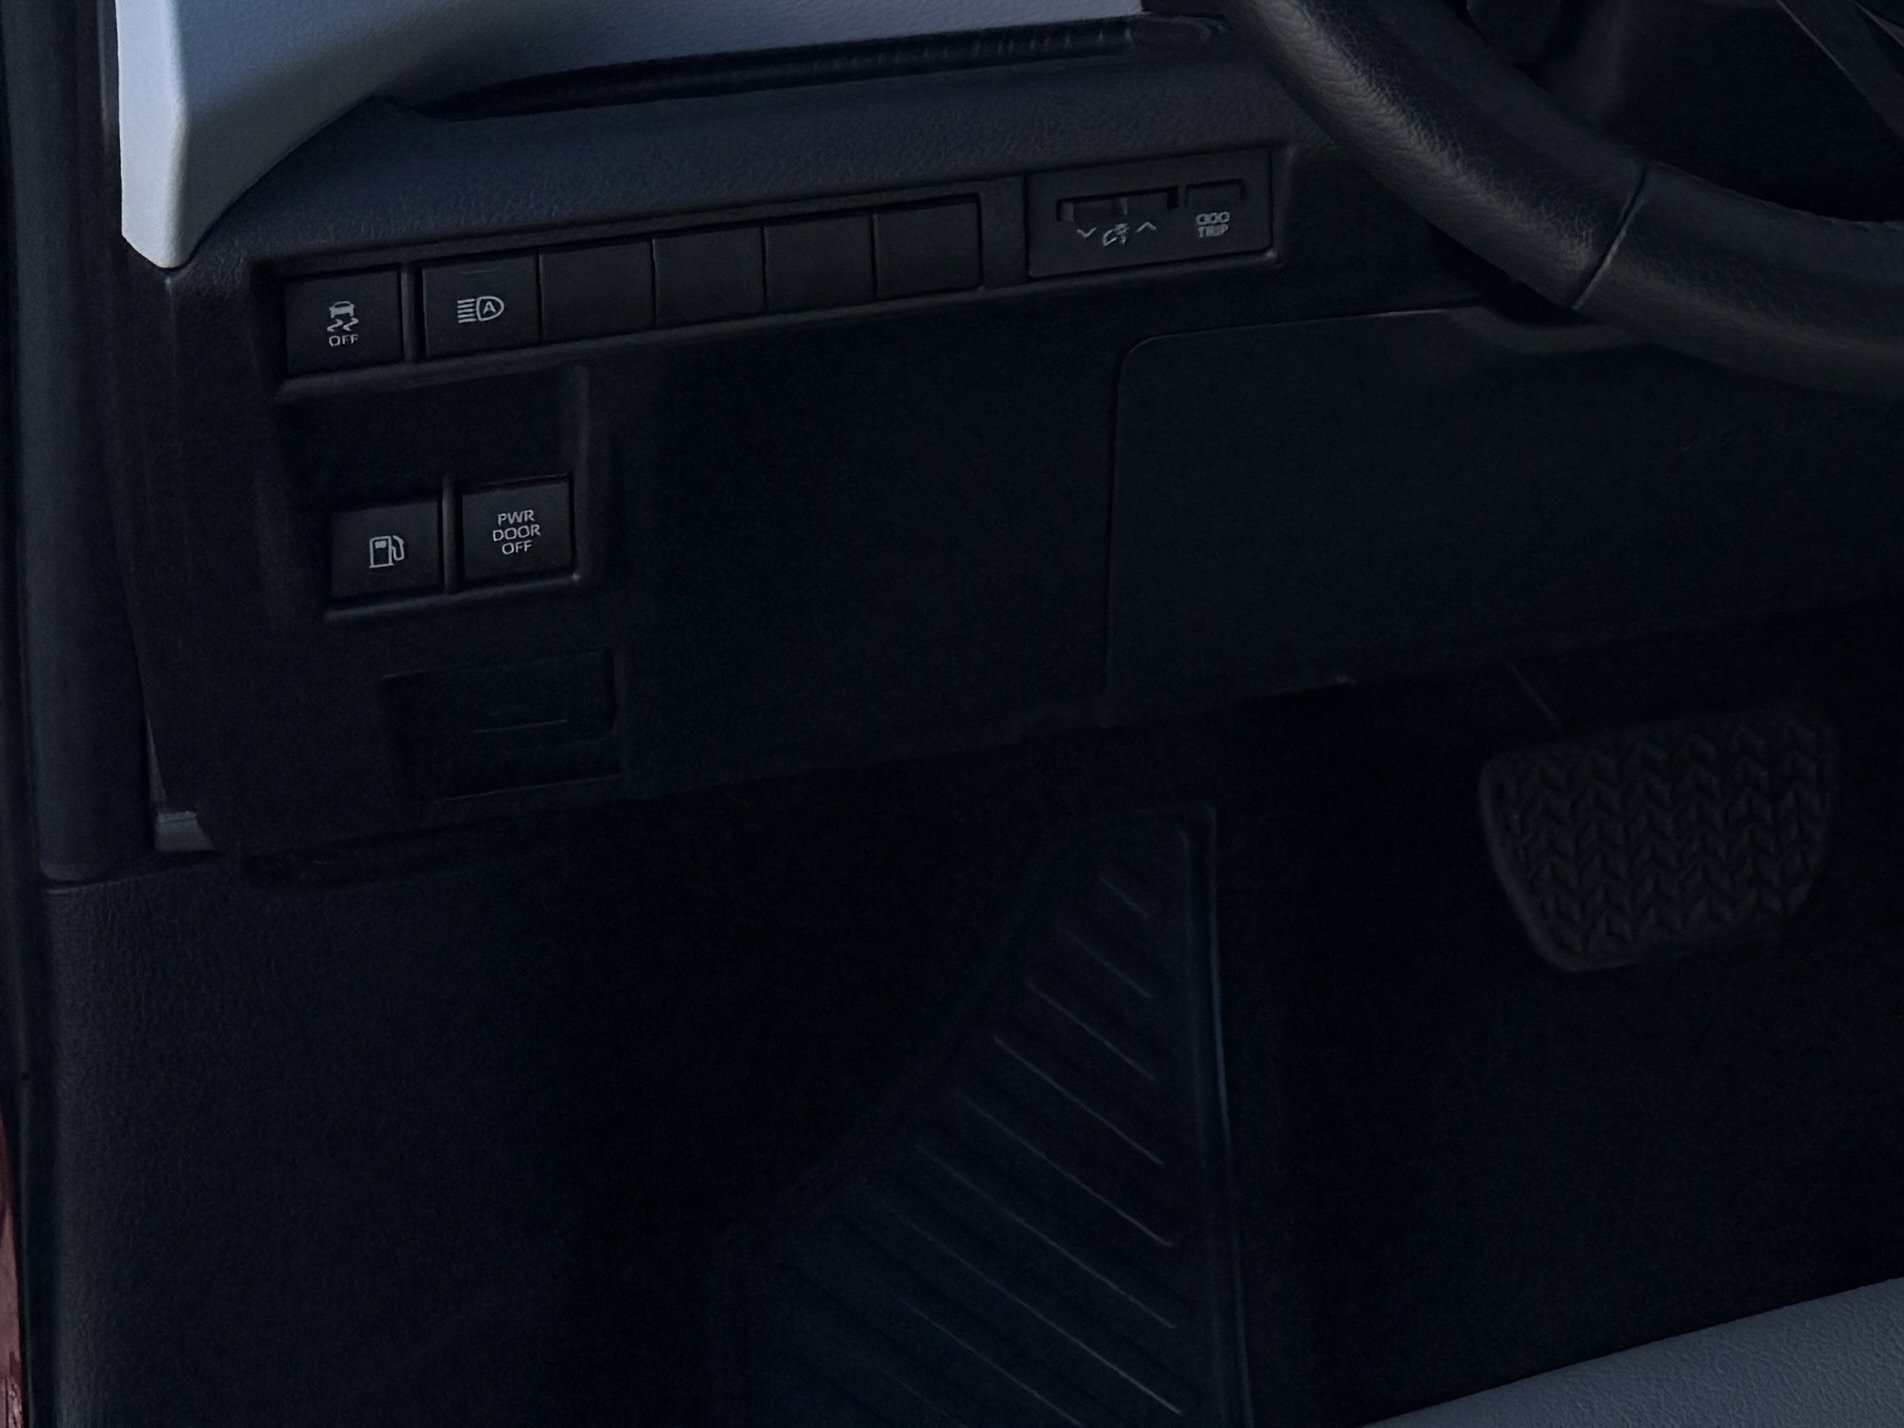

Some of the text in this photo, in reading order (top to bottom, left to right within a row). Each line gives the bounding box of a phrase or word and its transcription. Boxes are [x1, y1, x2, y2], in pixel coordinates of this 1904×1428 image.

[327, 332, 360, 348] OFF
[497, 508, 536, 526] PWR
[492, 523, 542, 543] DOOR
[501, 539, 534, 556] OFF
